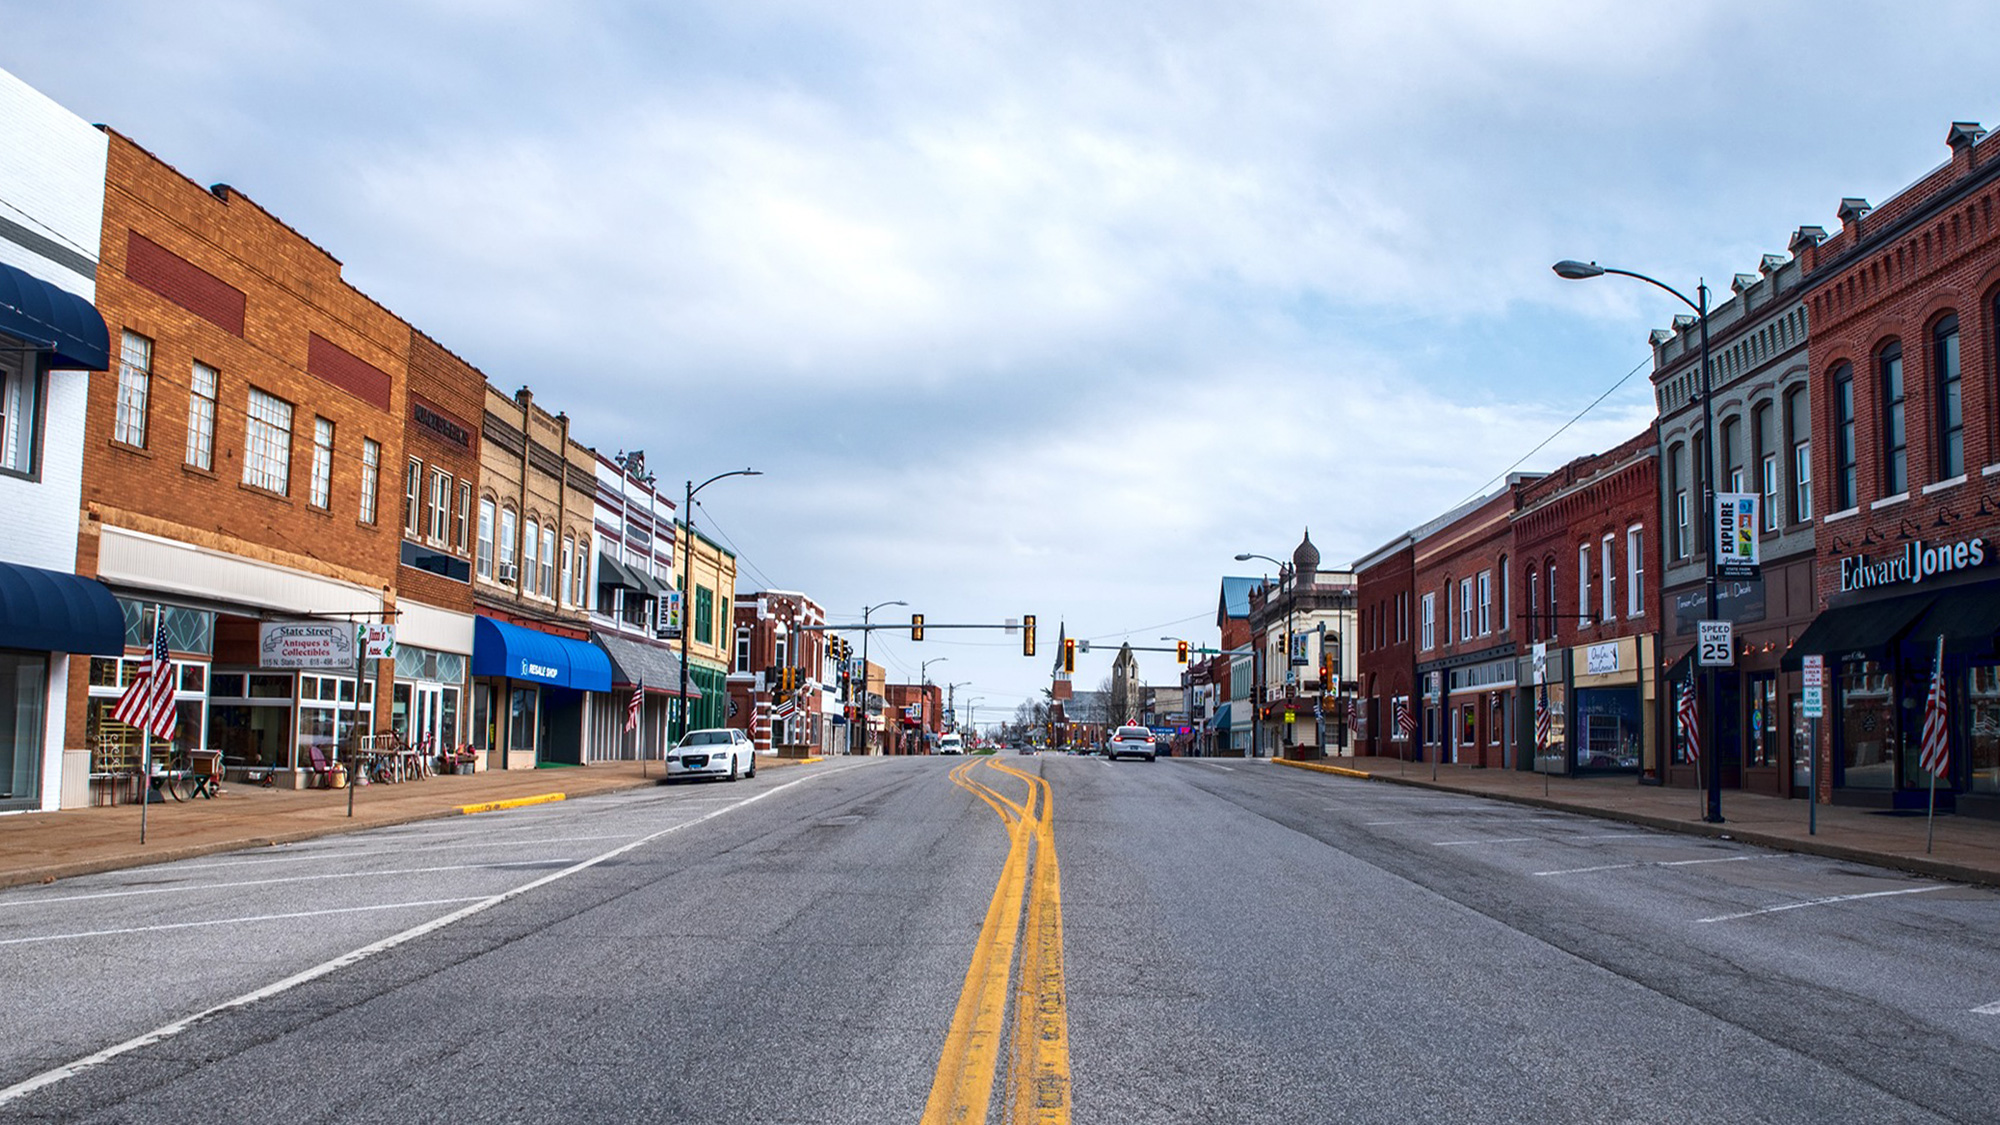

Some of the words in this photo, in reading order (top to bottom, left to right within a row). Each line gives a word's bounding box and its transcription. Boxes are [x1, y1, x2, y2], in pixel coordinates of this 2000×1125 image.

[1721, 502, 1734, 553] EXPLORE
[1840, 543, 1911, 592] Edward
[1912, 538, 1984, 584] Jones
[280, 627, 304, 636] State
[307, 628, 334, 636] Street
[368, 628, 385, 644] Jim's
[1704, 634, 1726, 642] LIMIT
[283, 640, 320, 649] Antiques
[282, 648, 330, 656] Collectibles
[368, 647, 382, 655] Attic
[1703, 644, 1730, 660] 25
[281, 658, 296, 666] State
[529, 664, 546, 676] RESALE
[546, 667, 558, 678] SHOP
